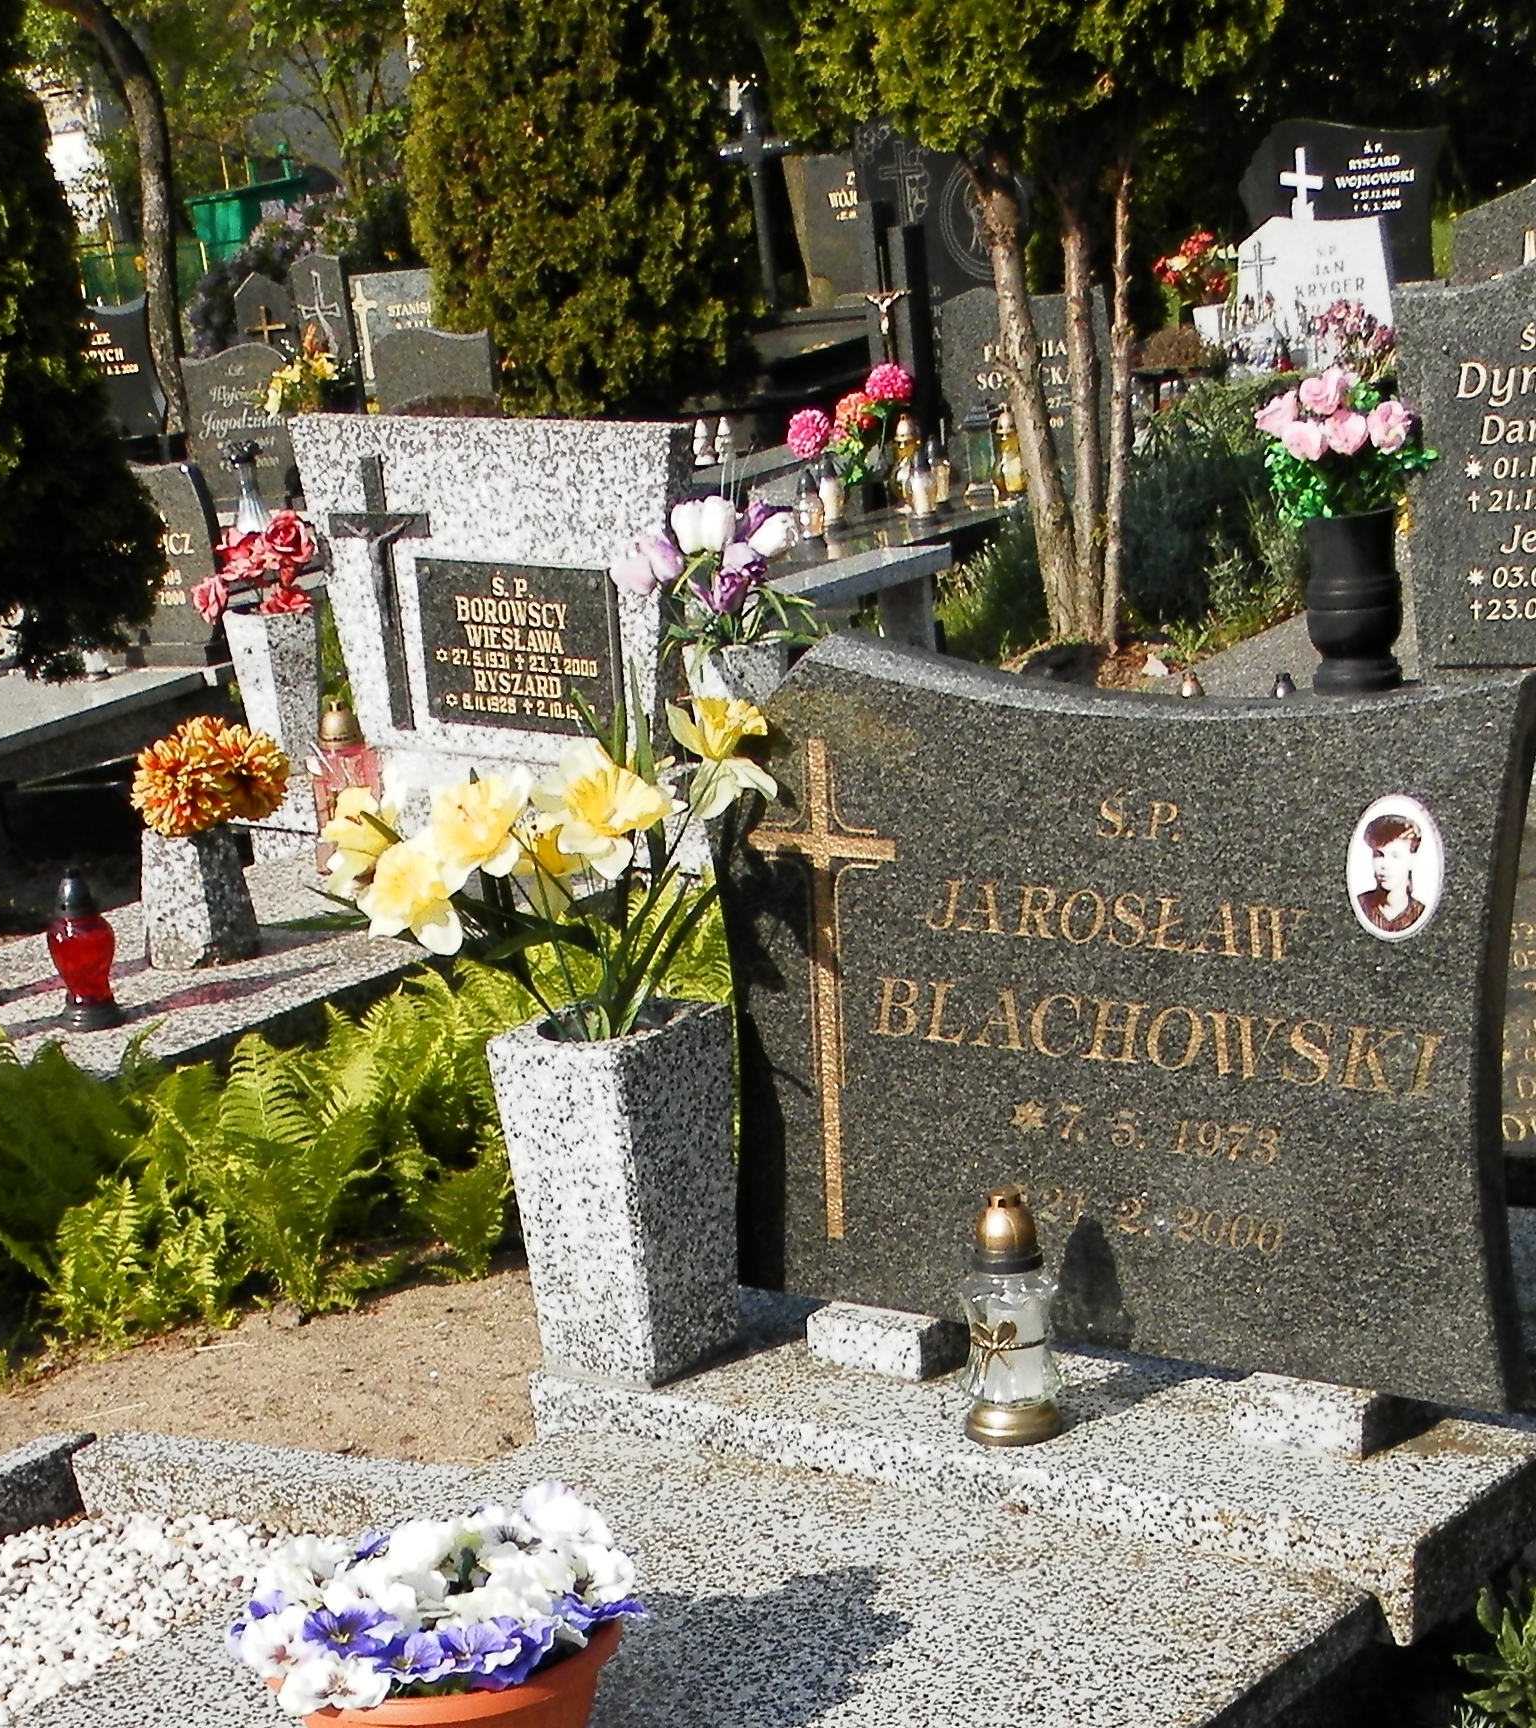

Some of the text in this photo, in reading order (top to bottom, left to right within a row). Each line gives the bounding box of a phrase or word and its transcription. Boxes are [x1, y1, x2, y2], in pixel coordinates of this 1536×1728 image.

[1348, 154, 1401, 171] RYSZARD
[1334, 168, 1415, 190] WOJNOWSKI
[1311, 259, 1345, 276] JAN
[1294, 276, 1365, 299] KRYGER
[454, 595, 567, 630] BOROWSCY
[465, 624, 565, 655] WIESŁAWA
[472, 668, 562, 699] RYSZARD
[923, 877, 1309, 963] JAROSŁAW
[868, 975, 1446, 1098] BLACHOWSKI
[1166, 1117, 1283, 1166] 1973
[1173, 1203, 1285, 1253] 2000
